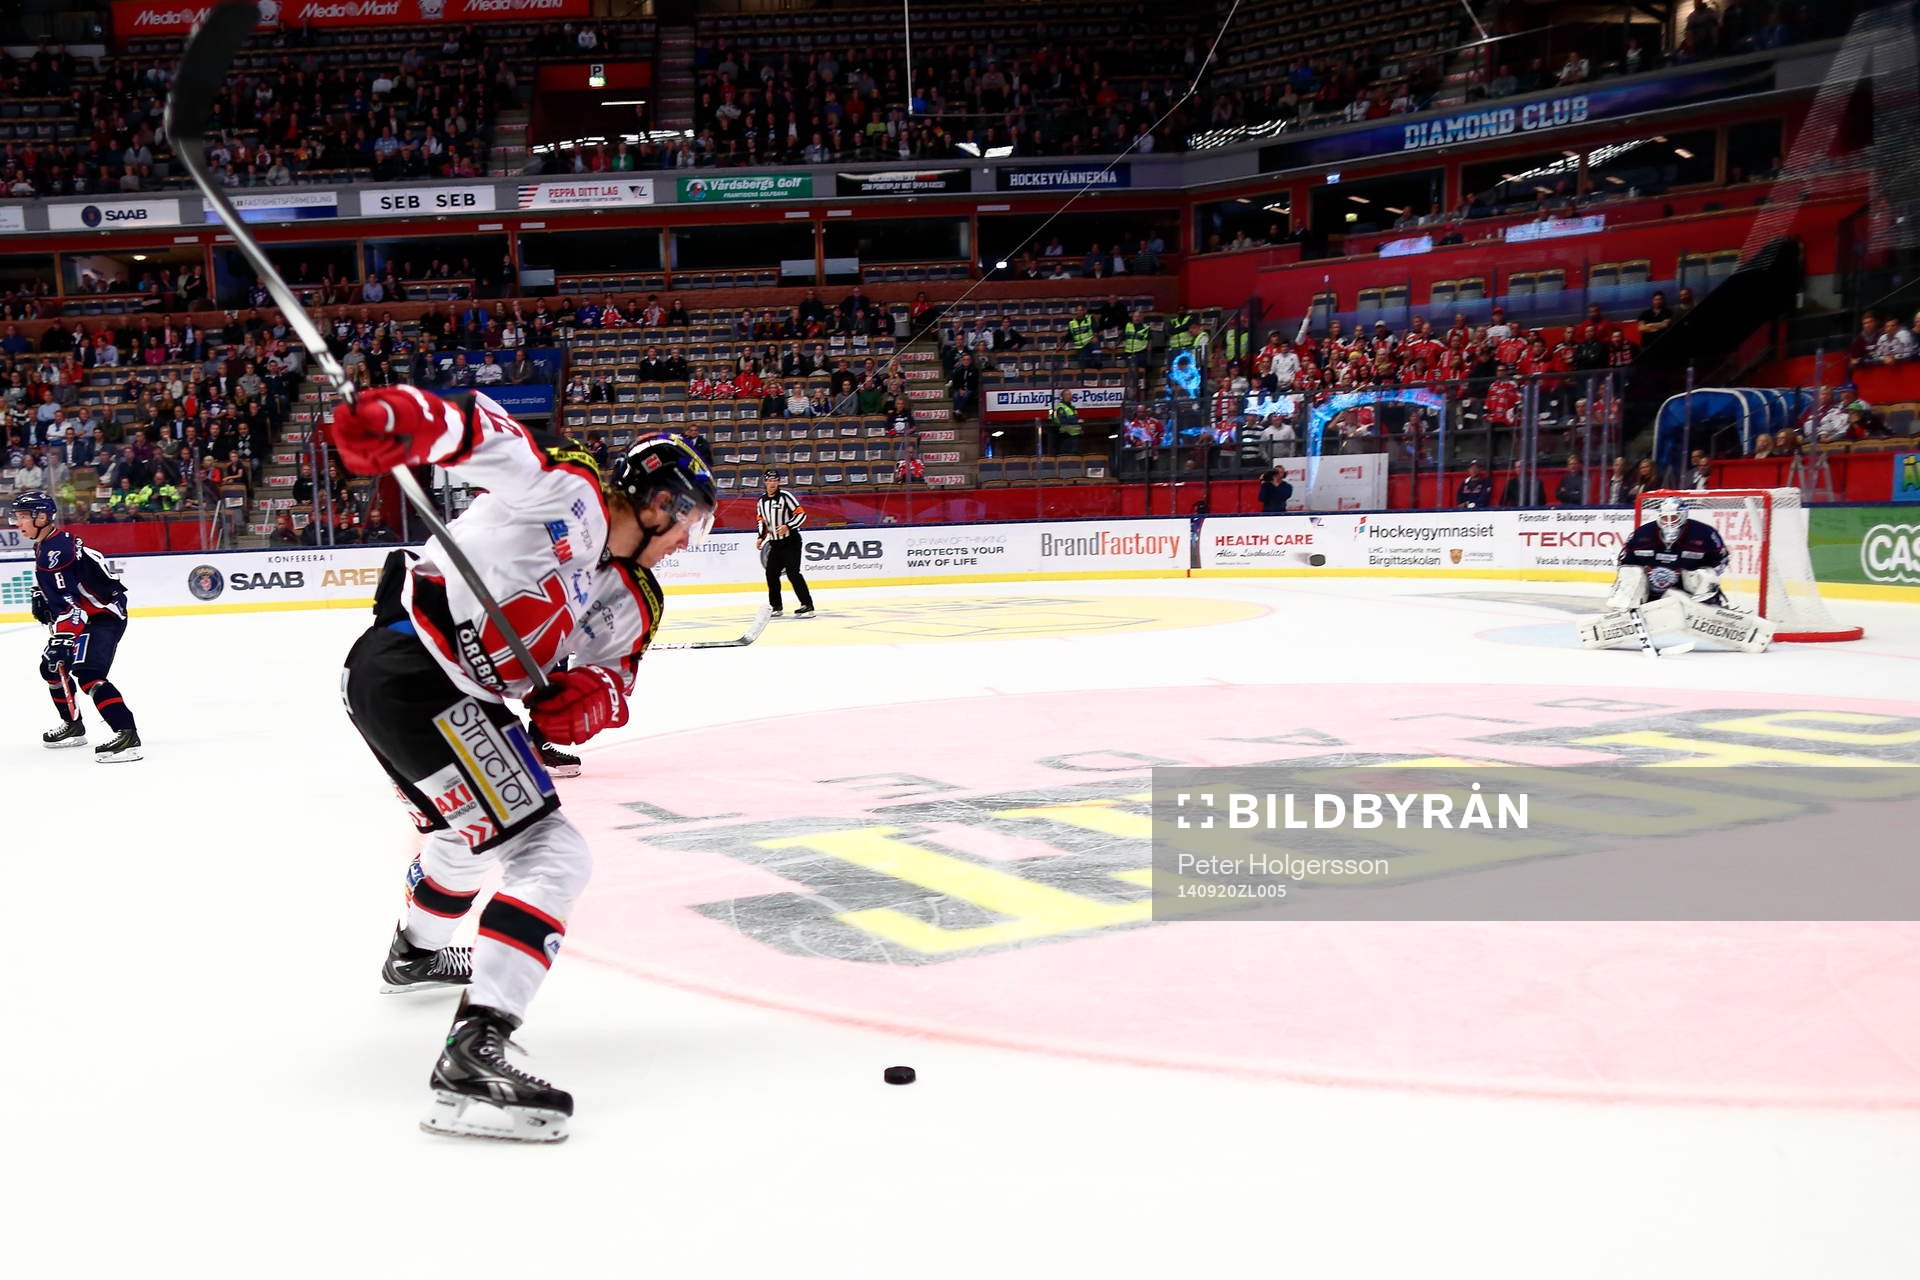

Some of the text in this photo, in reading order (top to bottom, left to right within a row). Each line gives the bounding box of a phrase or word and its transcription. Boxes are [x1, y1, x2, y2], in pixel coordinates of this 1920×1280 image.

[1404, 95, 1589, 150] DIAMOND CLUB
[710, 177, 803, 192] Vårdsbergs Golf
[1009, 170, 1117, 187] HOCKEYVÄNNERNA
[548, 185, 619, 198] PEPPA DITT LAG
[381, 193, 476, 210] SEB SEB
[105, 208, 148, 221] SAAB
[1010, 389, 1123, 407] Linköps-Posten
[1215, 534, 1314, 547] HEALTH CARE
[1369, 523, 1495, 541] Hockeygymnasiet
[804, 540, 883, 562] SAAB
[907, 546, 1004, 557] PROTECTS YOUR
[1041, 531, 1181, 559] BrandFactory
[268, 554, 325, 563] KONFERERA
[804, 561, 884, 572] Defence and Security
[907, 557, 977, 568] WAY OF LIFE
[1369, 554, 1441, 567] Birgittaskolan
[230, 571, 304, 591] SAAB
[321, 567, 384, 587] ARE
[1692, 618, 1747, 642] LEGENDS
[450, 702, 533, 811] Structor
[434, 782, 474, 816] AXI
